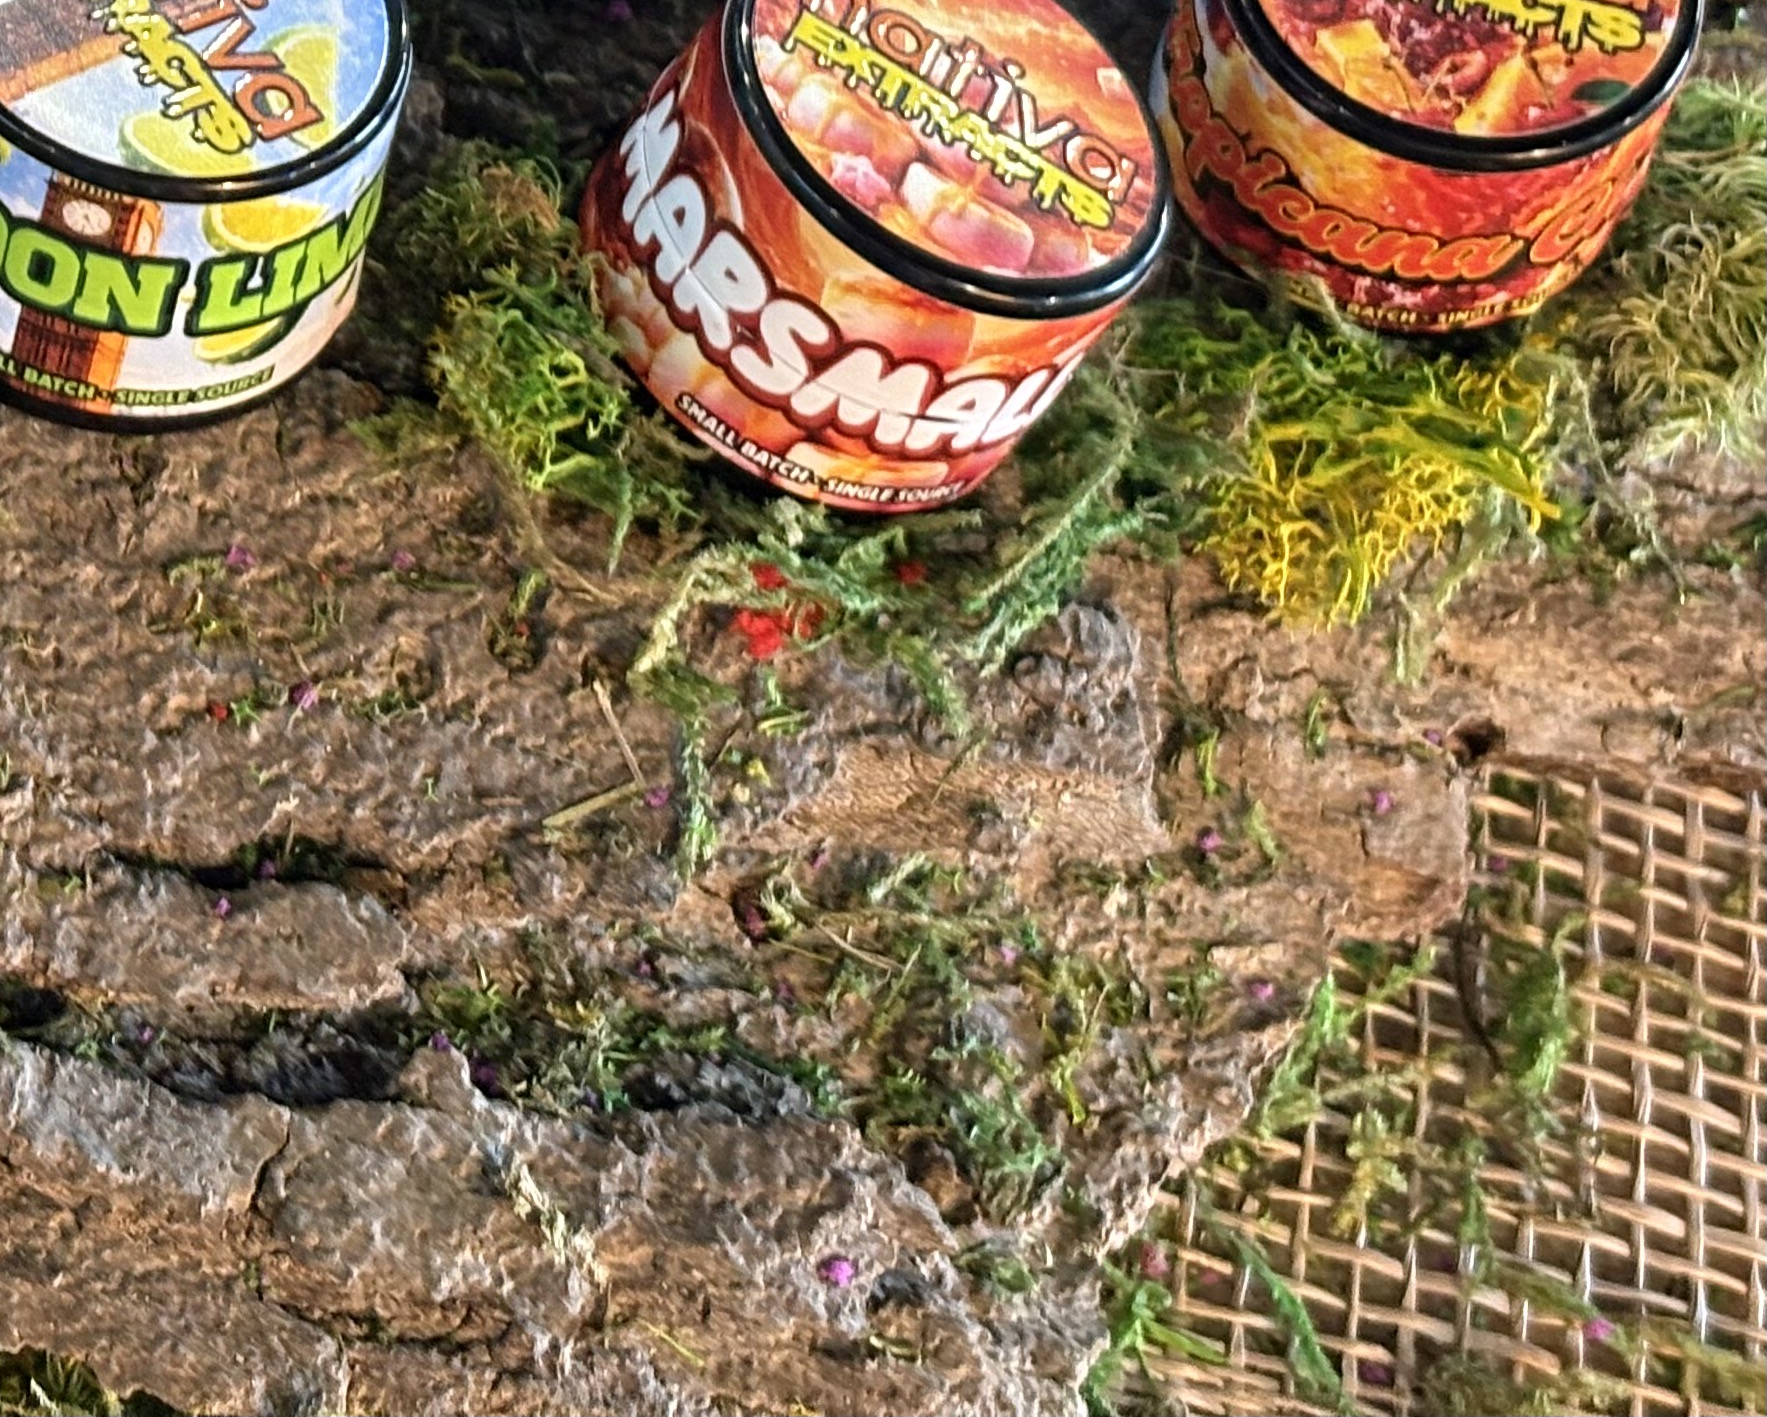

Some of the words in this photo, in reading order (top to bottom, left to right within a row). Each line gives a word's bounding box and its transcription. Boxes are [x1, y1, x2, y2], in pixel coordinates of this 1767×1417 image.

[783, 4, 1118, 230] EXTRACTS
[23, 364, 96, 401] BATCH
[115, 387, 190, 407] SINGLE
[676, 394, 739, 449] SMALL
[740, 440, 811, 483] BATCH
[823, 478, 897, 503] SINGLE
